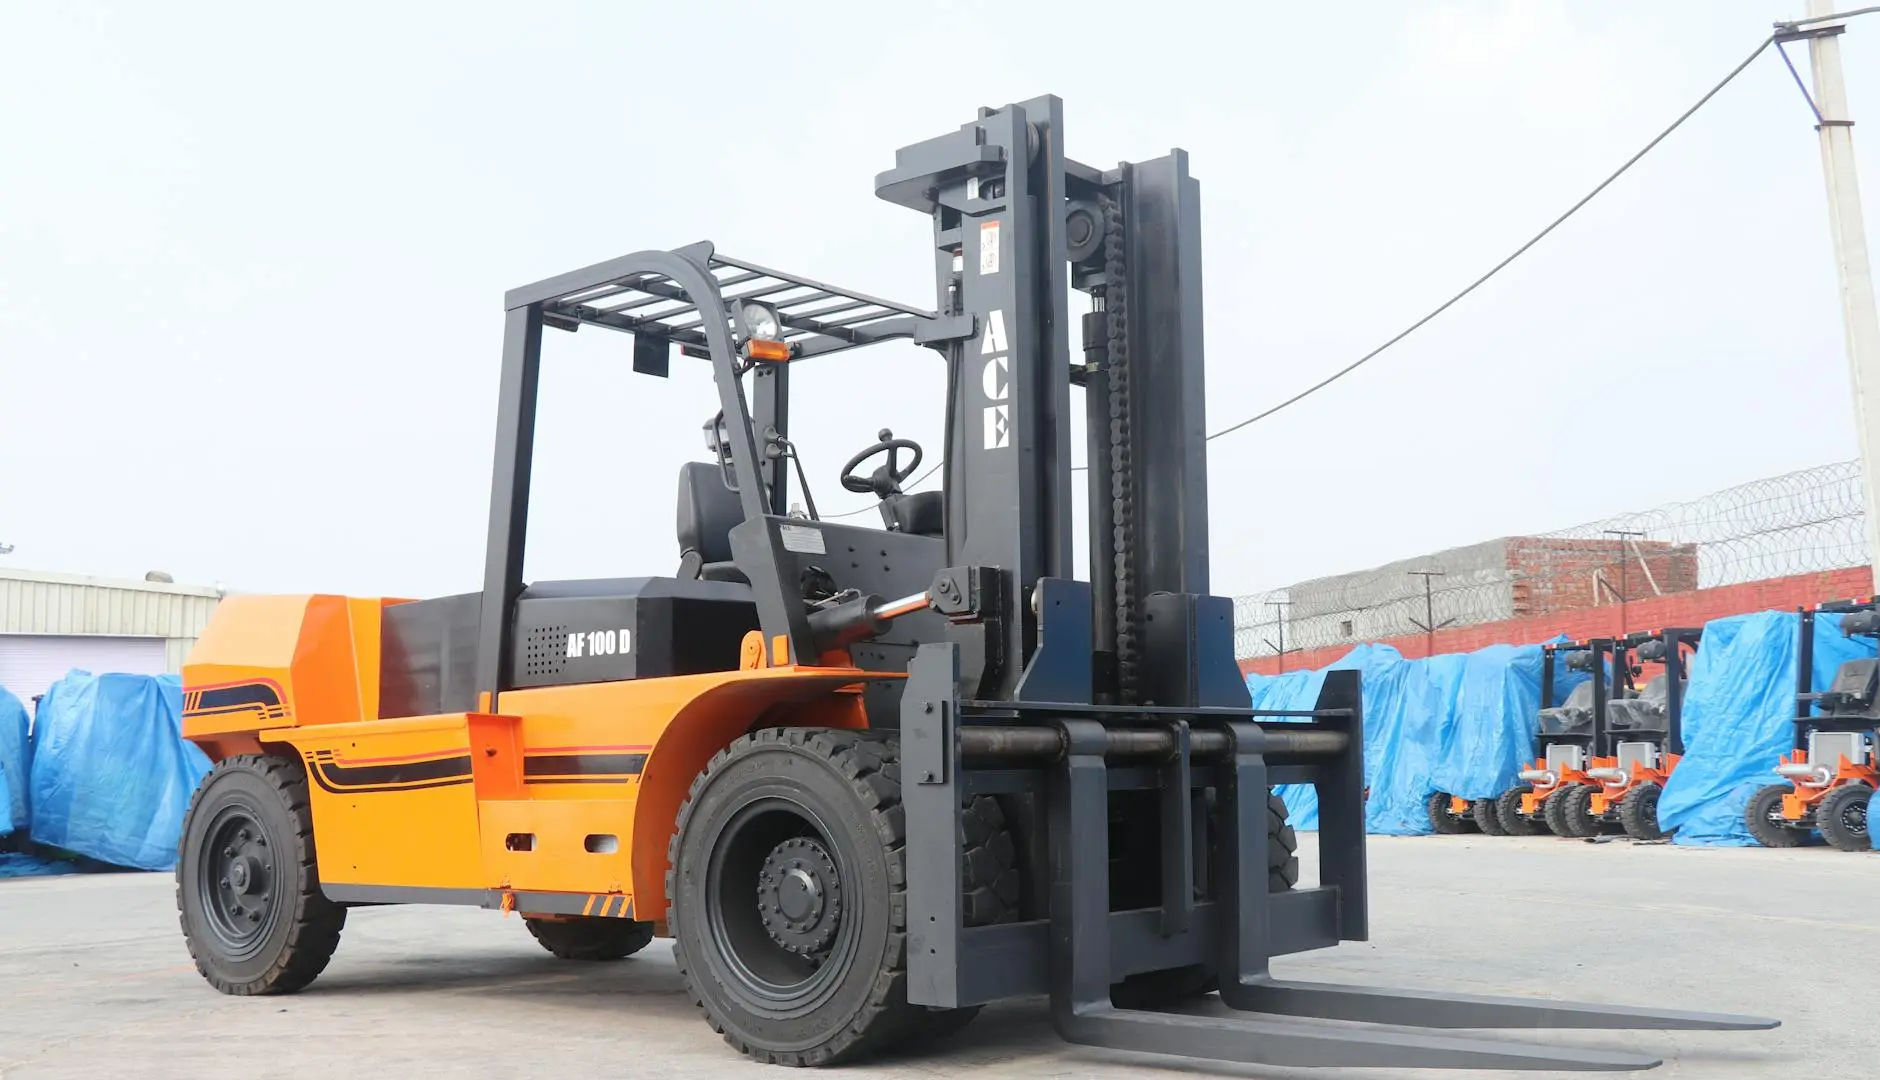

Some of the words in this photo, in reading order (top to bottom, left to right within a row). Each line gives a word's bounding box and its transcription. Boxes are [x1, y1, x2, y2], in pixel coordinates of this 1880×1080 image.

[980, 309, 1010, 450] ACE
[566, 632, 585, 658] AF
[587, 630, 616, 656] 100
[619, 629, 631, 654] D
